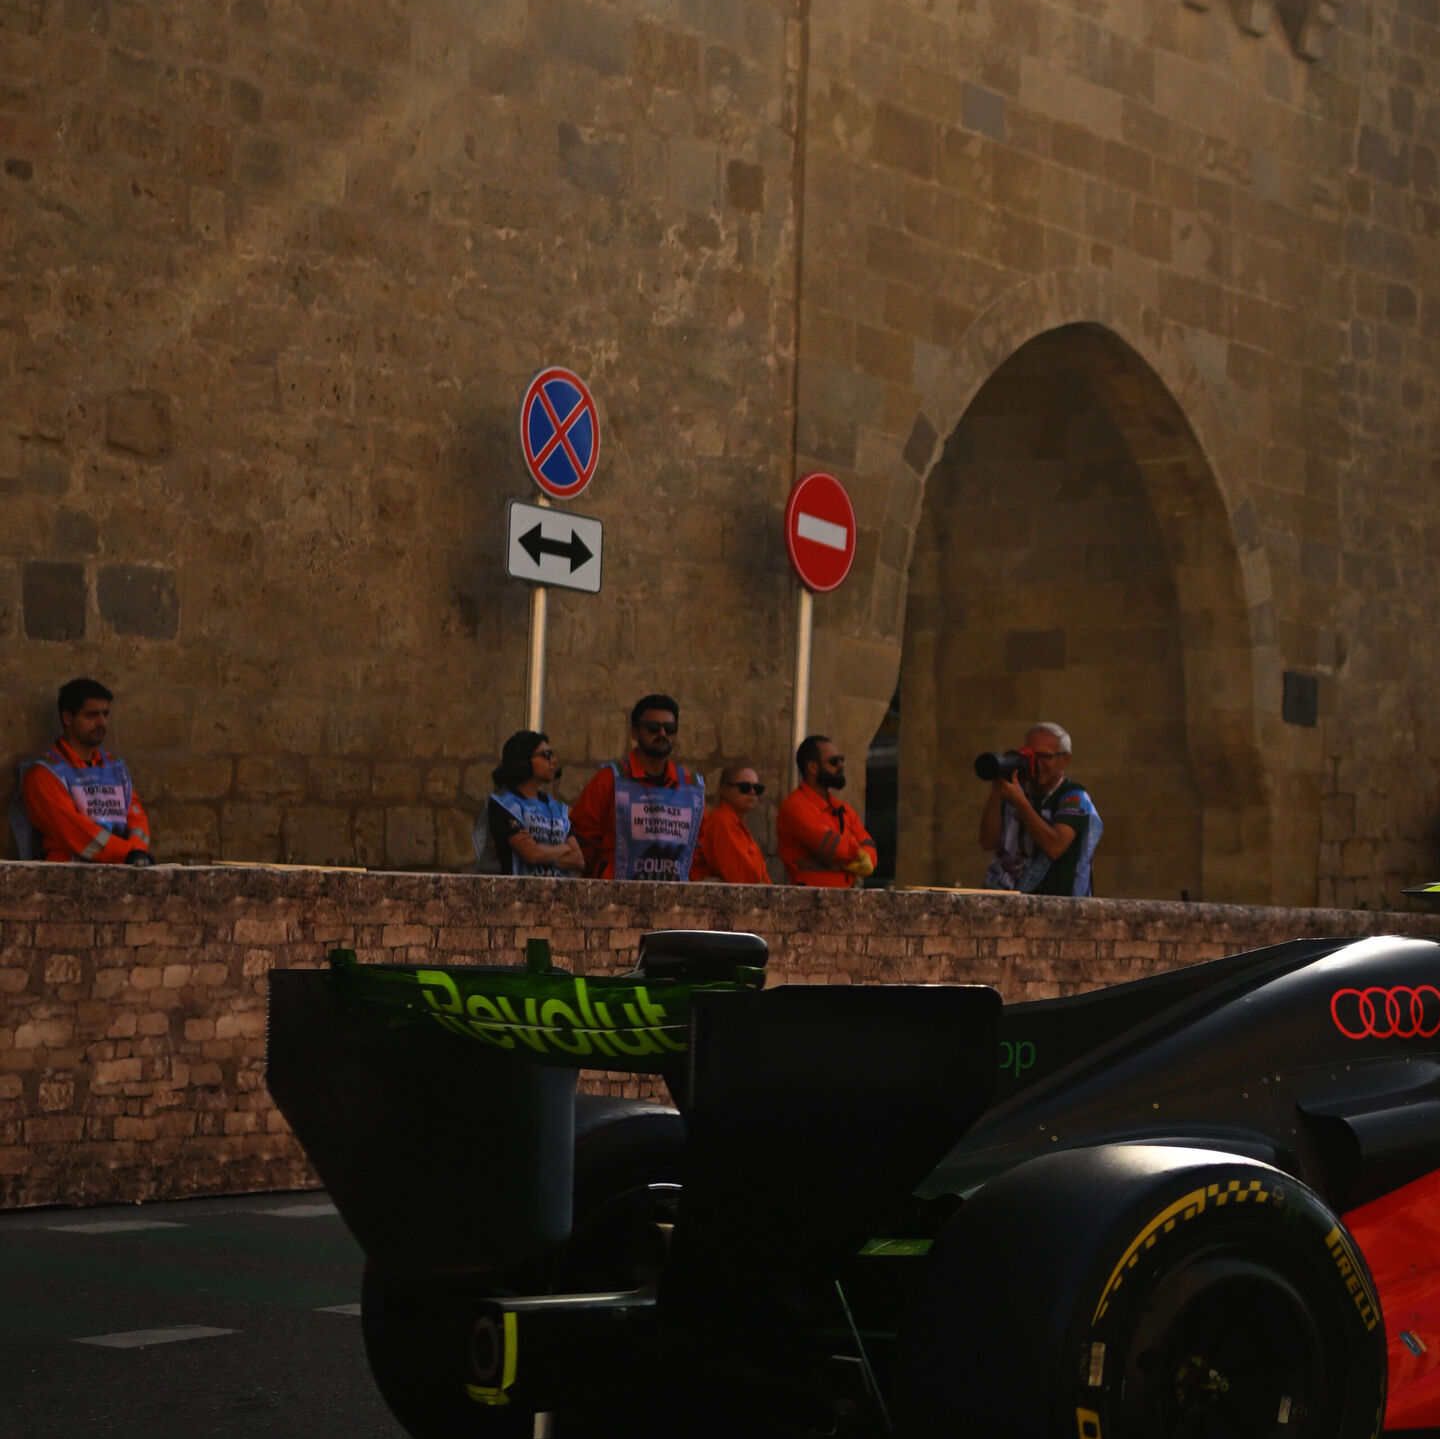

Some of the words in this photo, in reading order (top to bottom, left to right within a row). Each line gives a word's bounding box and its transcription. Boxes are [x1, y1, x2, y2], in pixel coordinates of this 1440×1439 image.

[634, 817, 691, 830] INTERVENTION
[416, 969, 688, 1057] Revolut
[1324, 1224, 1380, 1332] PIRELLI
